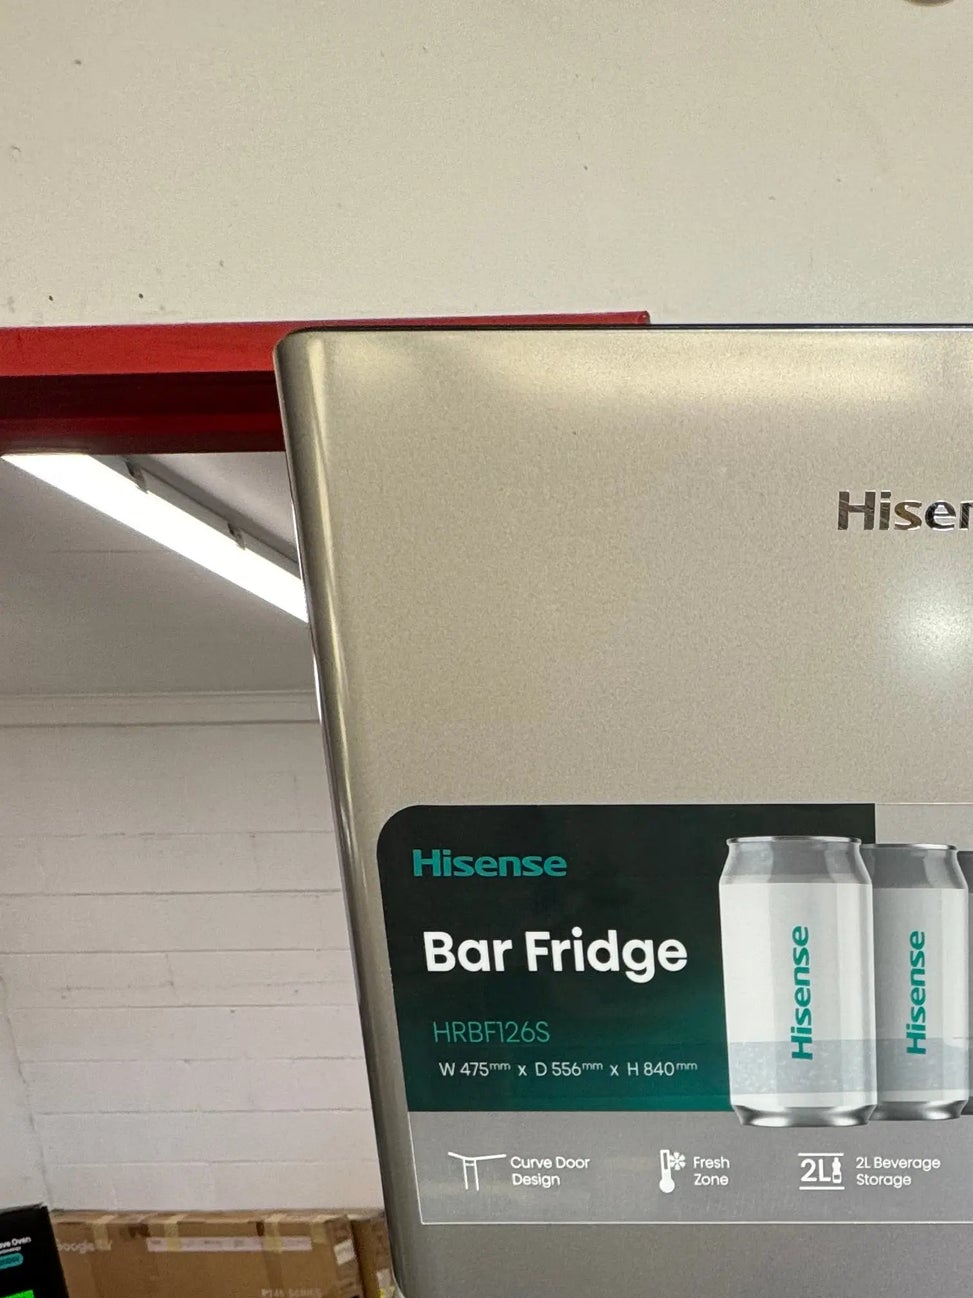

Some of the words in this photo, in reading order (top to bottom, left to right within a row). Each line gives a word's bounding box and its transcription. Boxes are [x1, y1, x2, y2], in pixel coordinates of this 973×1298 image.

[412, 849, 567, 877] Hisense
[423, 931, 513, 972] Bar
[525, 926, 688, 984] Fridge
[790, 925, 814, 1061] Hisense
[906, 930, 927, 1055] Hisense
[432, 1021, 551, 1044] HRBF126S
[438, 1062, 456, 1077] W
[518, 1064, 528, 1077] x
[535, 1062, 548, 1077] D
[610, 1064, 620, 1077] x
[627, 1062, 640, 1077] H
[510, 1156, 553, 1170] Curve
[555, 1156, 591, 1170] Door
[693, 1156, 730, 1170] Fresh
[799, 1158, 832, 1183] 2L
[855, 1156, 873, 1170] 2L
[874, 1156, 941, 1172] Beverage
[512, 1173, 561, 1188] Design
[693, 1173, 729, 1186] Zone
[856, 1173, 912, 1188] Storage
